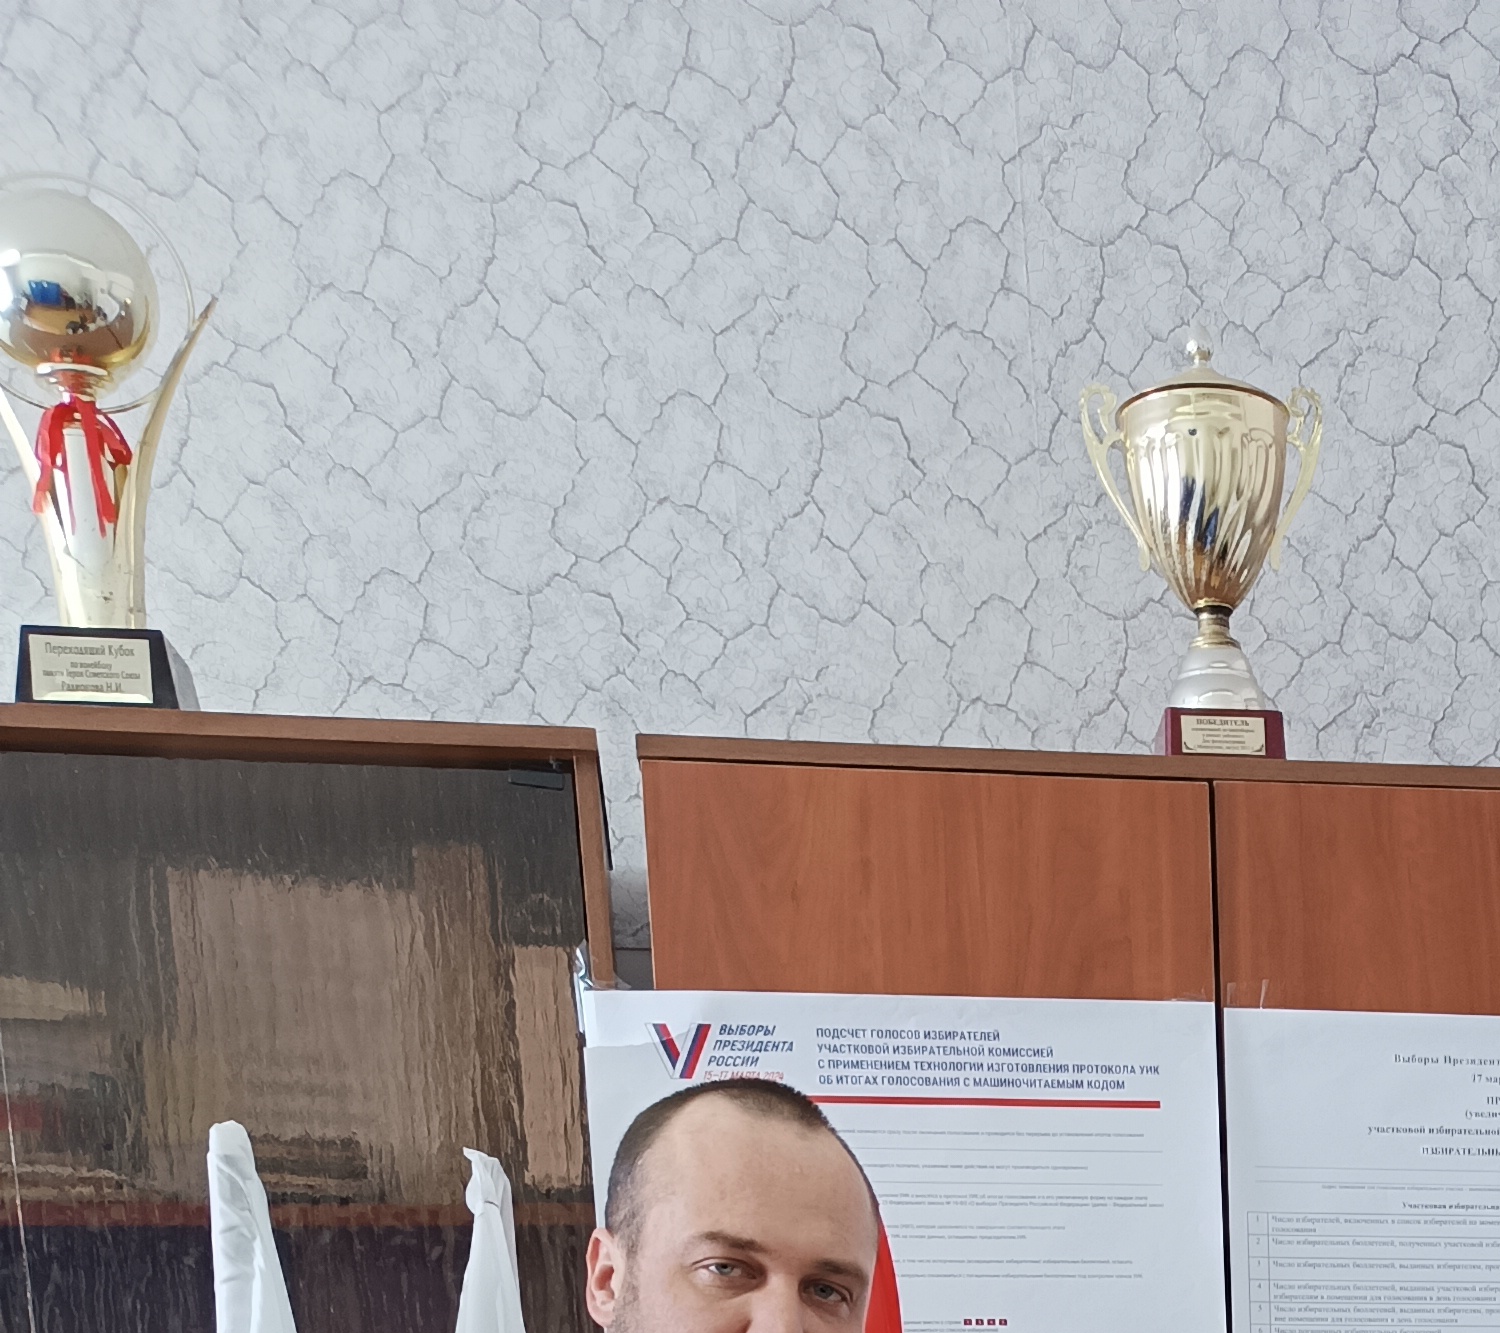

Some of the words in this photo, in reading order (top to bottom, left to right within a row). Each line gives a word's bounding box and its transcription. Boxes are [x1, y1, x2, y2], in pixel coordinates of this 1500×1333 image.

[719, 1024, 776, 1036] ВЫБОРЫ
[815, 1028, 865, 1040] ПОДСЧЕТ
[870, 1029, 920, 1041] ГОЛОСОВ
[923, 1029, 1000, 1041] ИЗБИРАТЕЛЕЙ
[713, 1040, 794, 1052] ПРЕЗИДЕНТА
[817, 1044, 889, 1056] УЧАСТКОВОЙ
[892, 1045, 984, 1057] ИЗБИРАТЕЛЬНОЙ
[987, 1045, 1053, 1058] КОМИССИЕЙ
[707, 1056, 760, 1067] РОССИИ
[817, 1060, 824, 1070] С
[827, 1060, 910, 1071] ПРИМЕНЕНИЕМ
[914, 1062, 984, 1073] ТЕХНОЛОГИИ
[986, 1063, 1069, 1074] ИЗГОТОВЛЕНИЯ
[1072, 1064, 1135, 1075] ПРОТОКОЛА
[1139, 1066, 1159, 1075] УИК
[818, 1075, 832, 1085] ОБ
[835, 1075, 878, 1086] ИТОГАХ
[881, 1076, 960, 1088] ГОЛОСОВАНИЯ
[963, 1077, 969, 1088] С
[972, 1077, 1084, 1090] МАШИНОЧИТАЕМЫМ
[1086, 1079, 1124, 1090] КОДОМ
